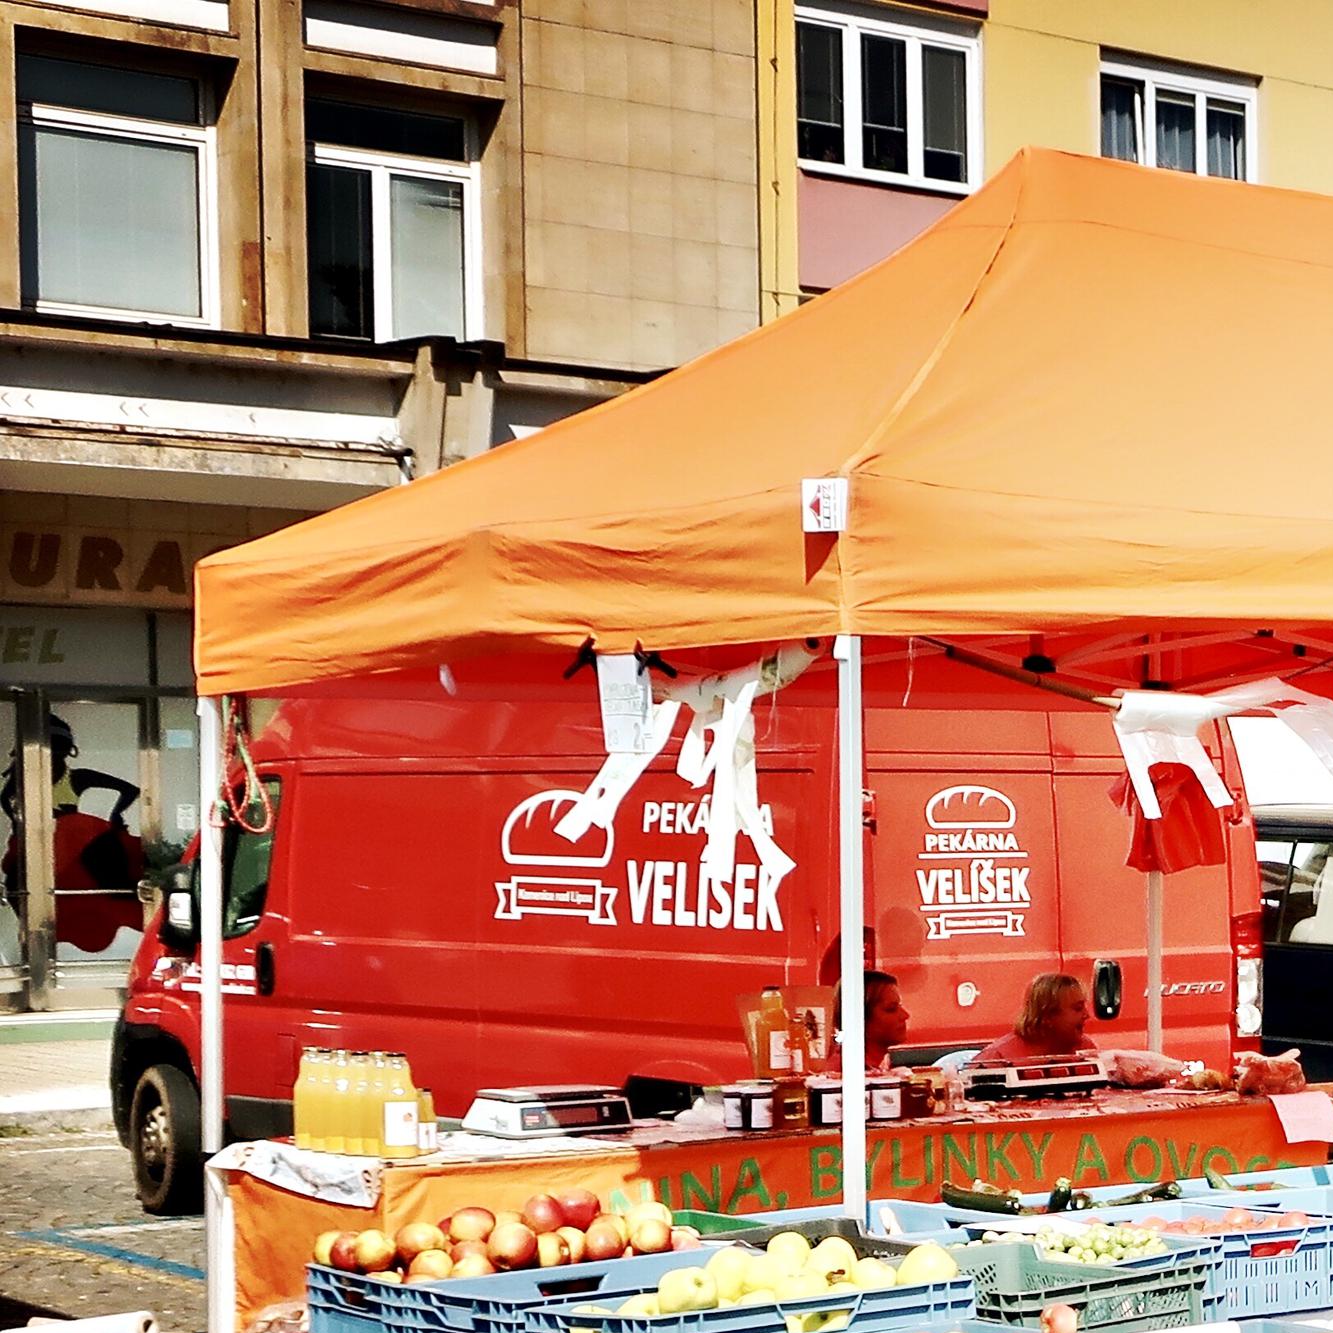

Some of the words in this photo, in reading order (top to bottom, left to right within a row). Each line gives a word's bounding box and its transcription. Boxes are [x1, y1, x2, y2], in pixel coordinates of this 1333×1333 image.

[642, 794, 774, 837] PEKÁA
[925, 829, 1019, 852] PEKÁRNA
[915, 859, 1031, 905] VELÍŠEK
[1072, 1132, 1107, 1182] A
[1126, 1136, 1299, 1183] OVO
